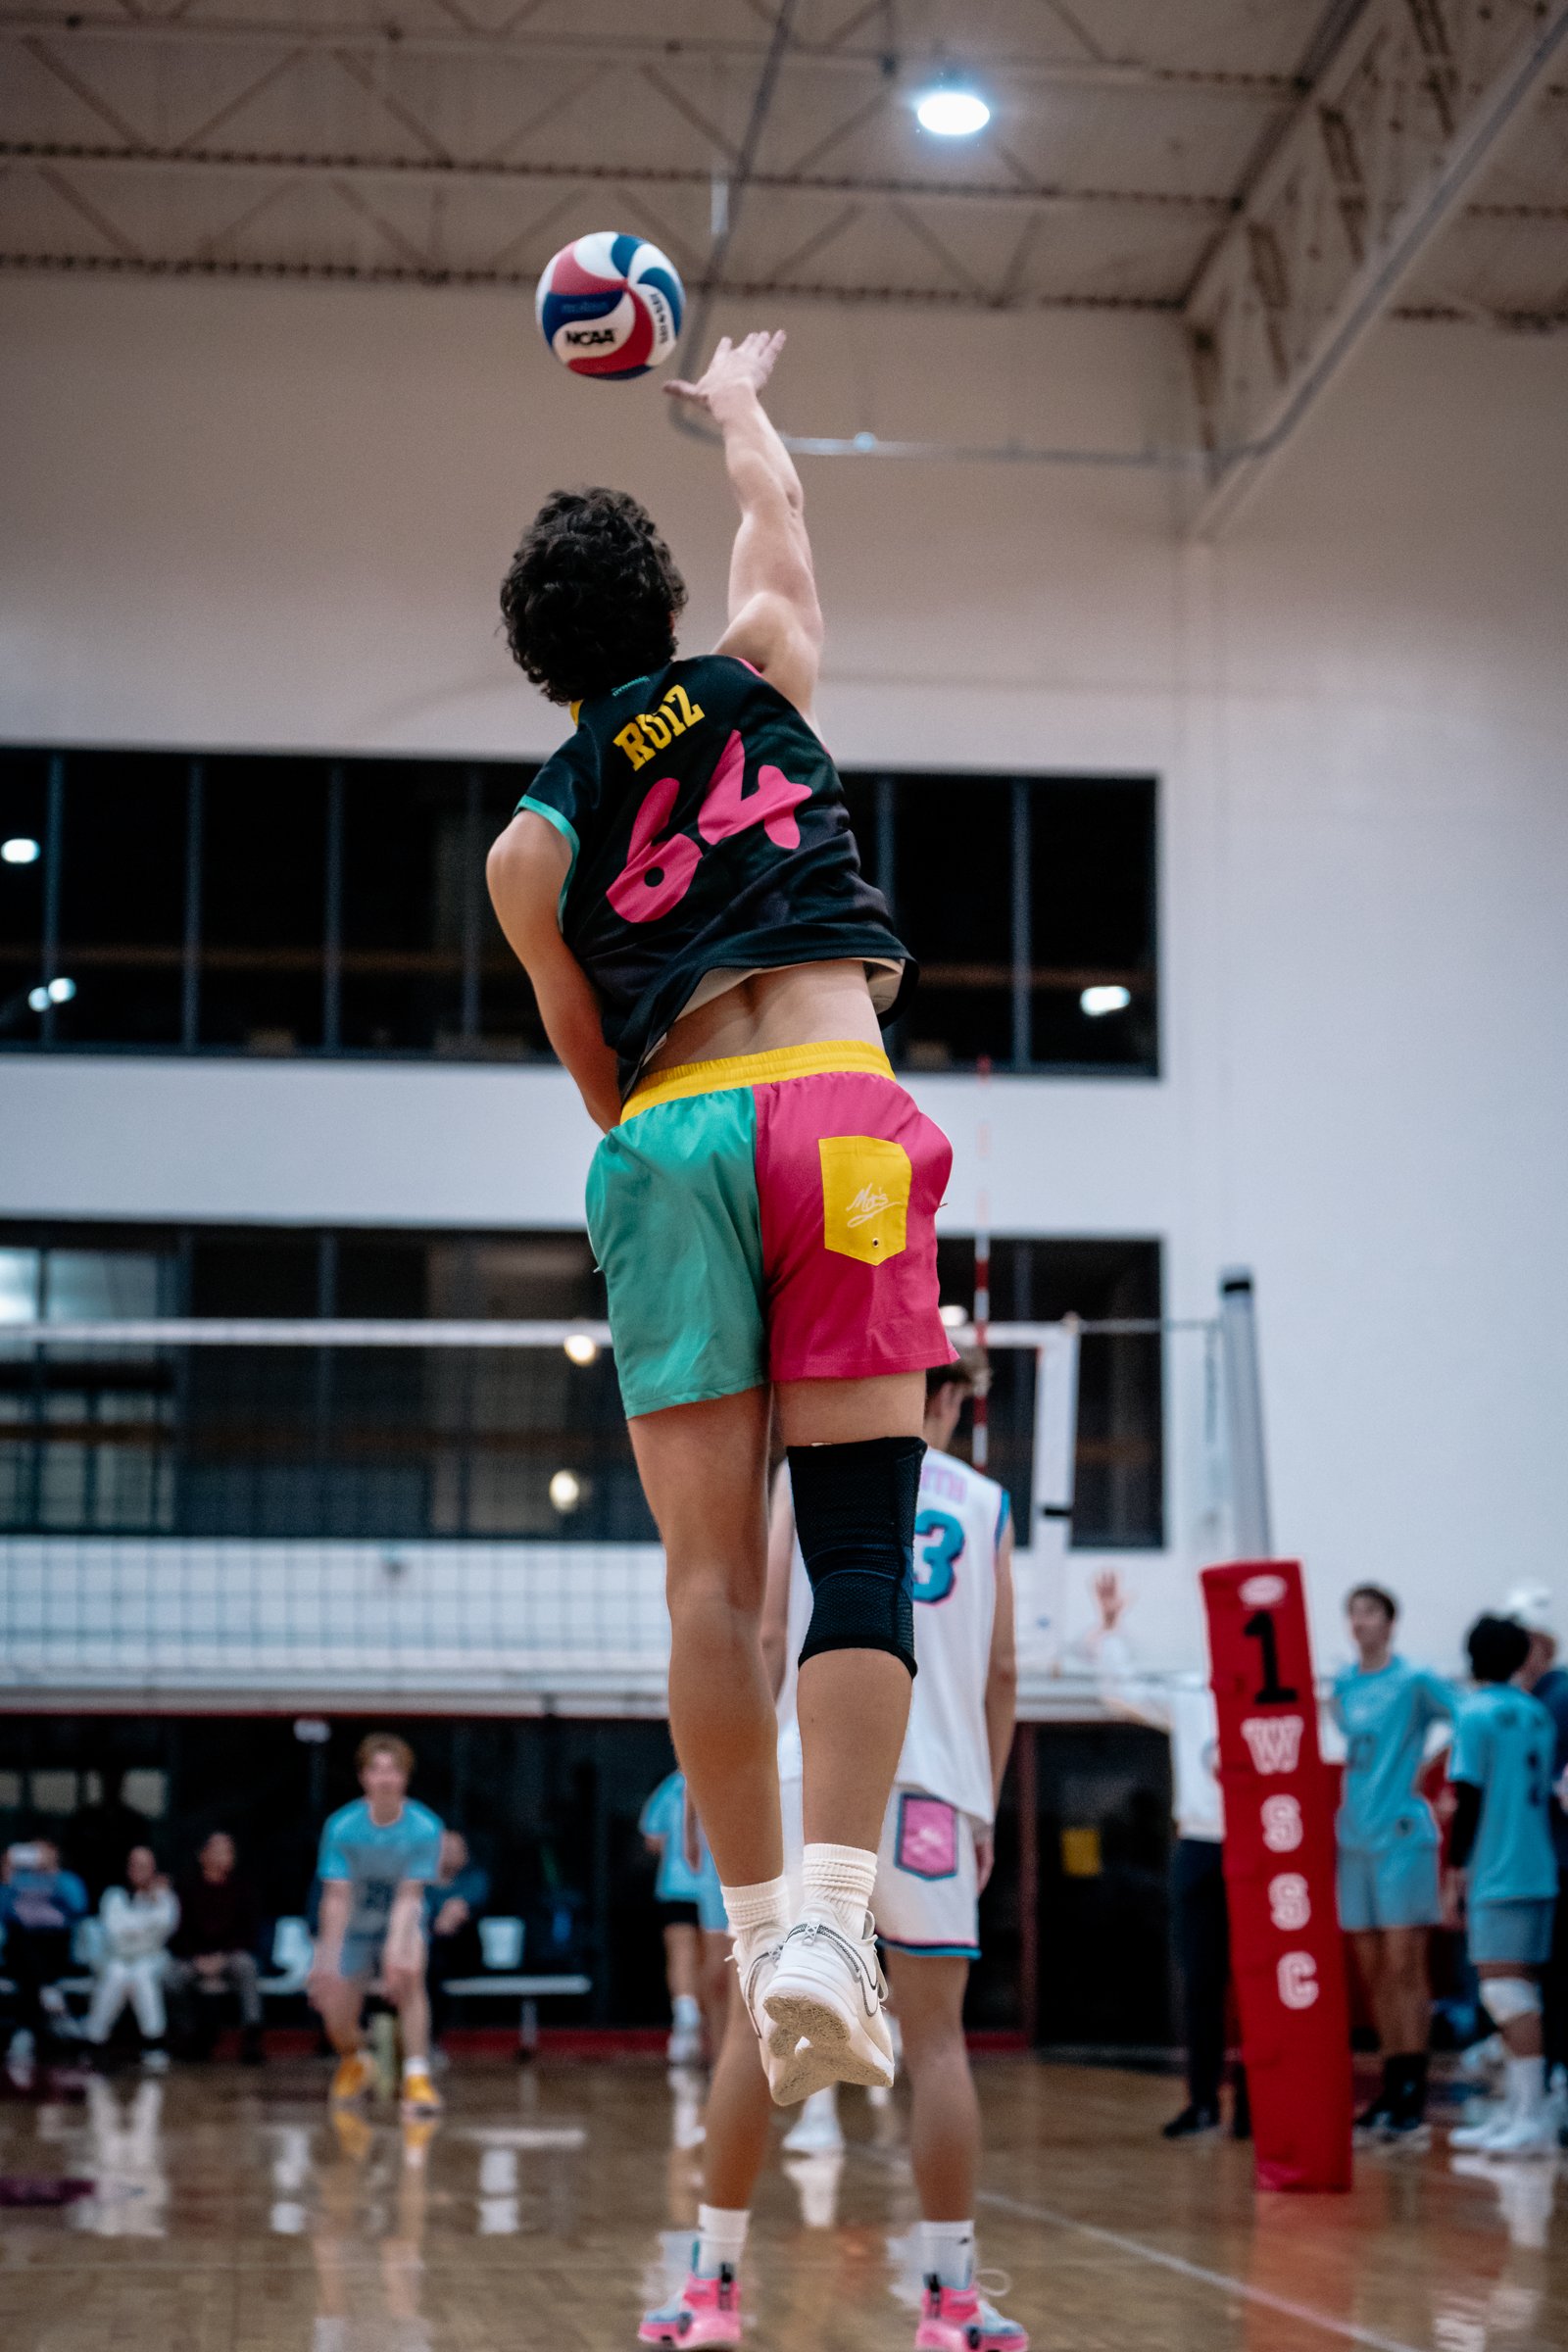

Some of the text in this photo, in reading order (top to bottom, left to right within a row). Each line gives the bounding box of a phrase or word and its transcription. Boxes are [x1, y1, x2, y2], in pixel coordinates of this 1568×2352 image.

[565, 328, 616, 346] NCAA
[612, 684, 706, 771] RUIZ
[606, 728, 813, 923] 64
[1244, 1609, 1298, 1704] 1
